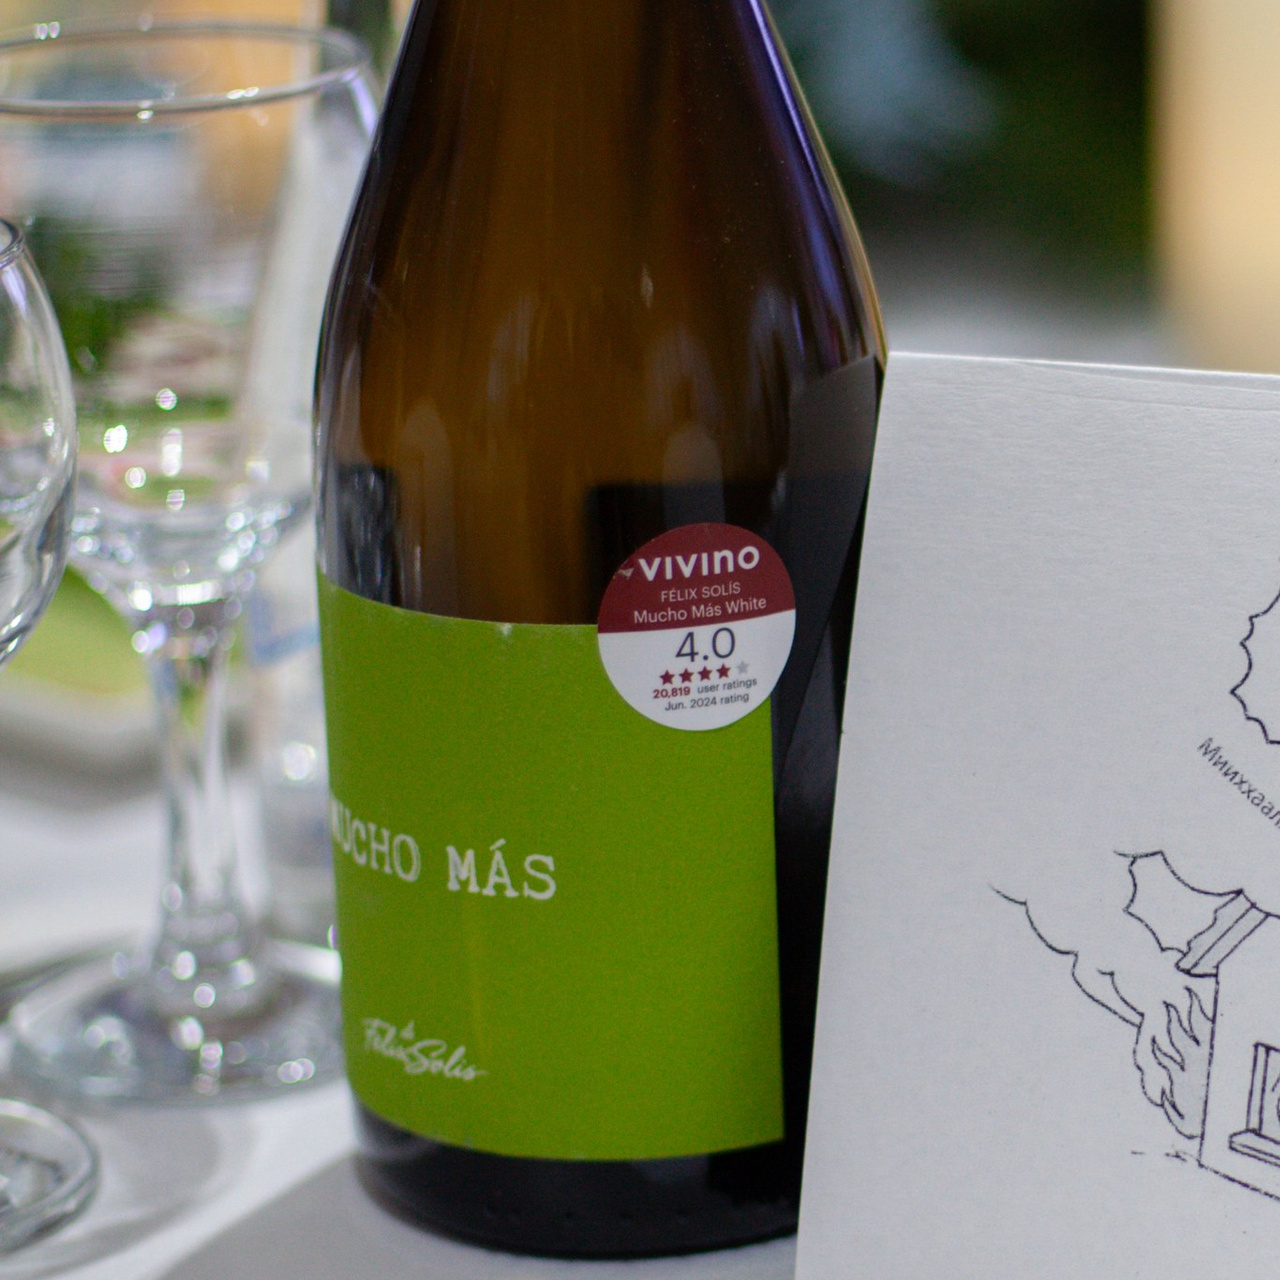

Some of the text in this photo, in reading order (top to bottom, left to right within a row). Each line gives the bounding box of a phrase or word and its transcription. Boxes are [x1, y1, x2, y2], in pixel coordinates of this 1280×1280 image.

[660, 581, 742, 603] FÉLIX SOLÍS
[634, 596, 767, 624] Mucho Más White
[675, 626, 736, 663] 4.0
[652, 677, 758, 699] 20,819 user ratings
[664, 692, 750, 711] Jun. 2024 rating
[446, 838, 557, 900] MÁS
